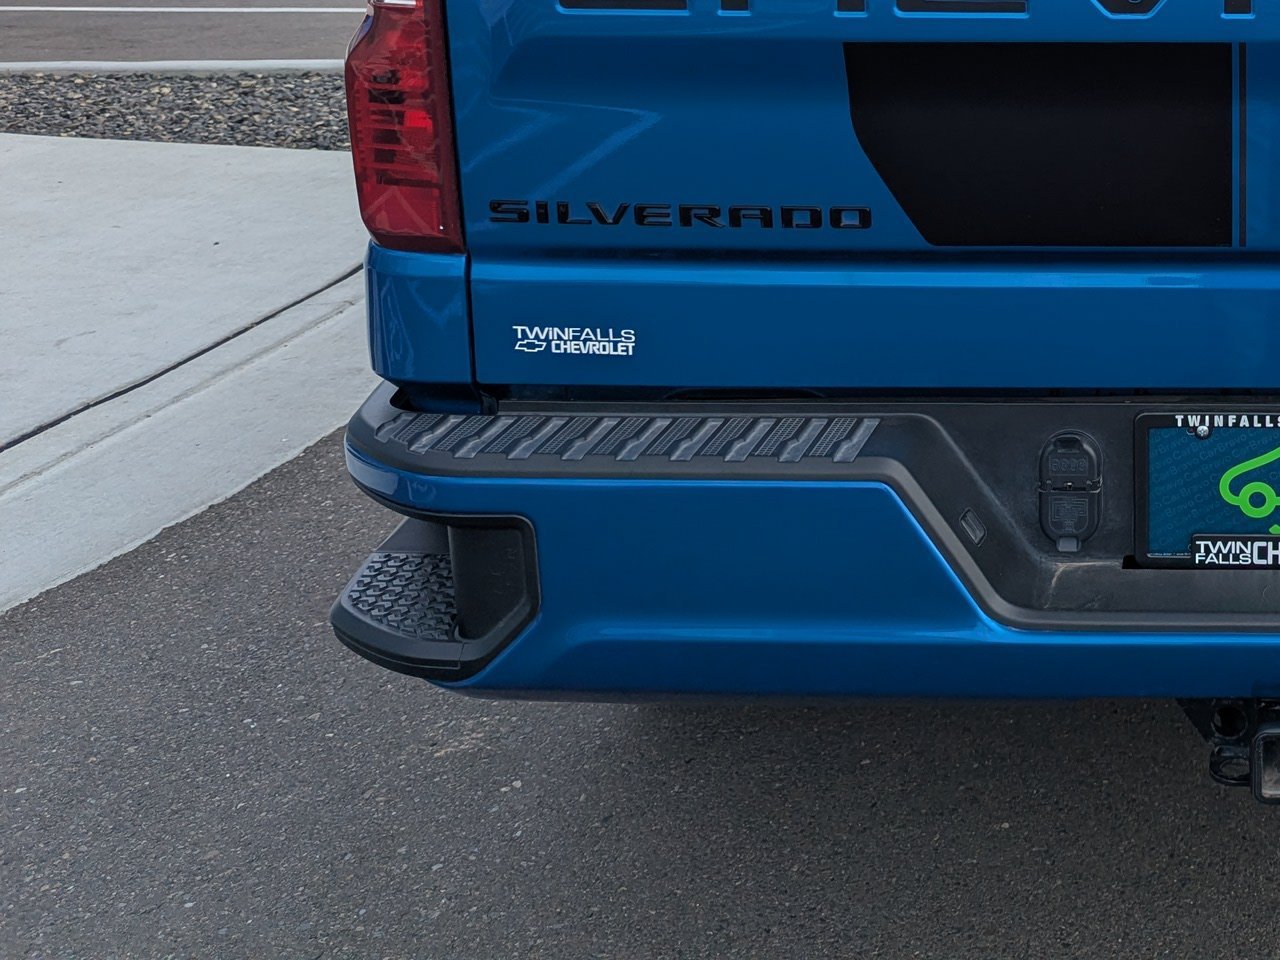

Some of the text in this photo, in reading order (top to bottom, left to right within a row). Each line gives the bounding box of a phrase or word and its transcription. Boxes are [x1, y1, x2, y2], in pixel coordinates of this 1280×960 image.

[488, 199, 873, 230] SILVERADO
[551, 340, 636, 356] CHEVROLET
[1196, 540, 1251, 554] TWIN
[1195, 553, 1252, 565] FALLS
